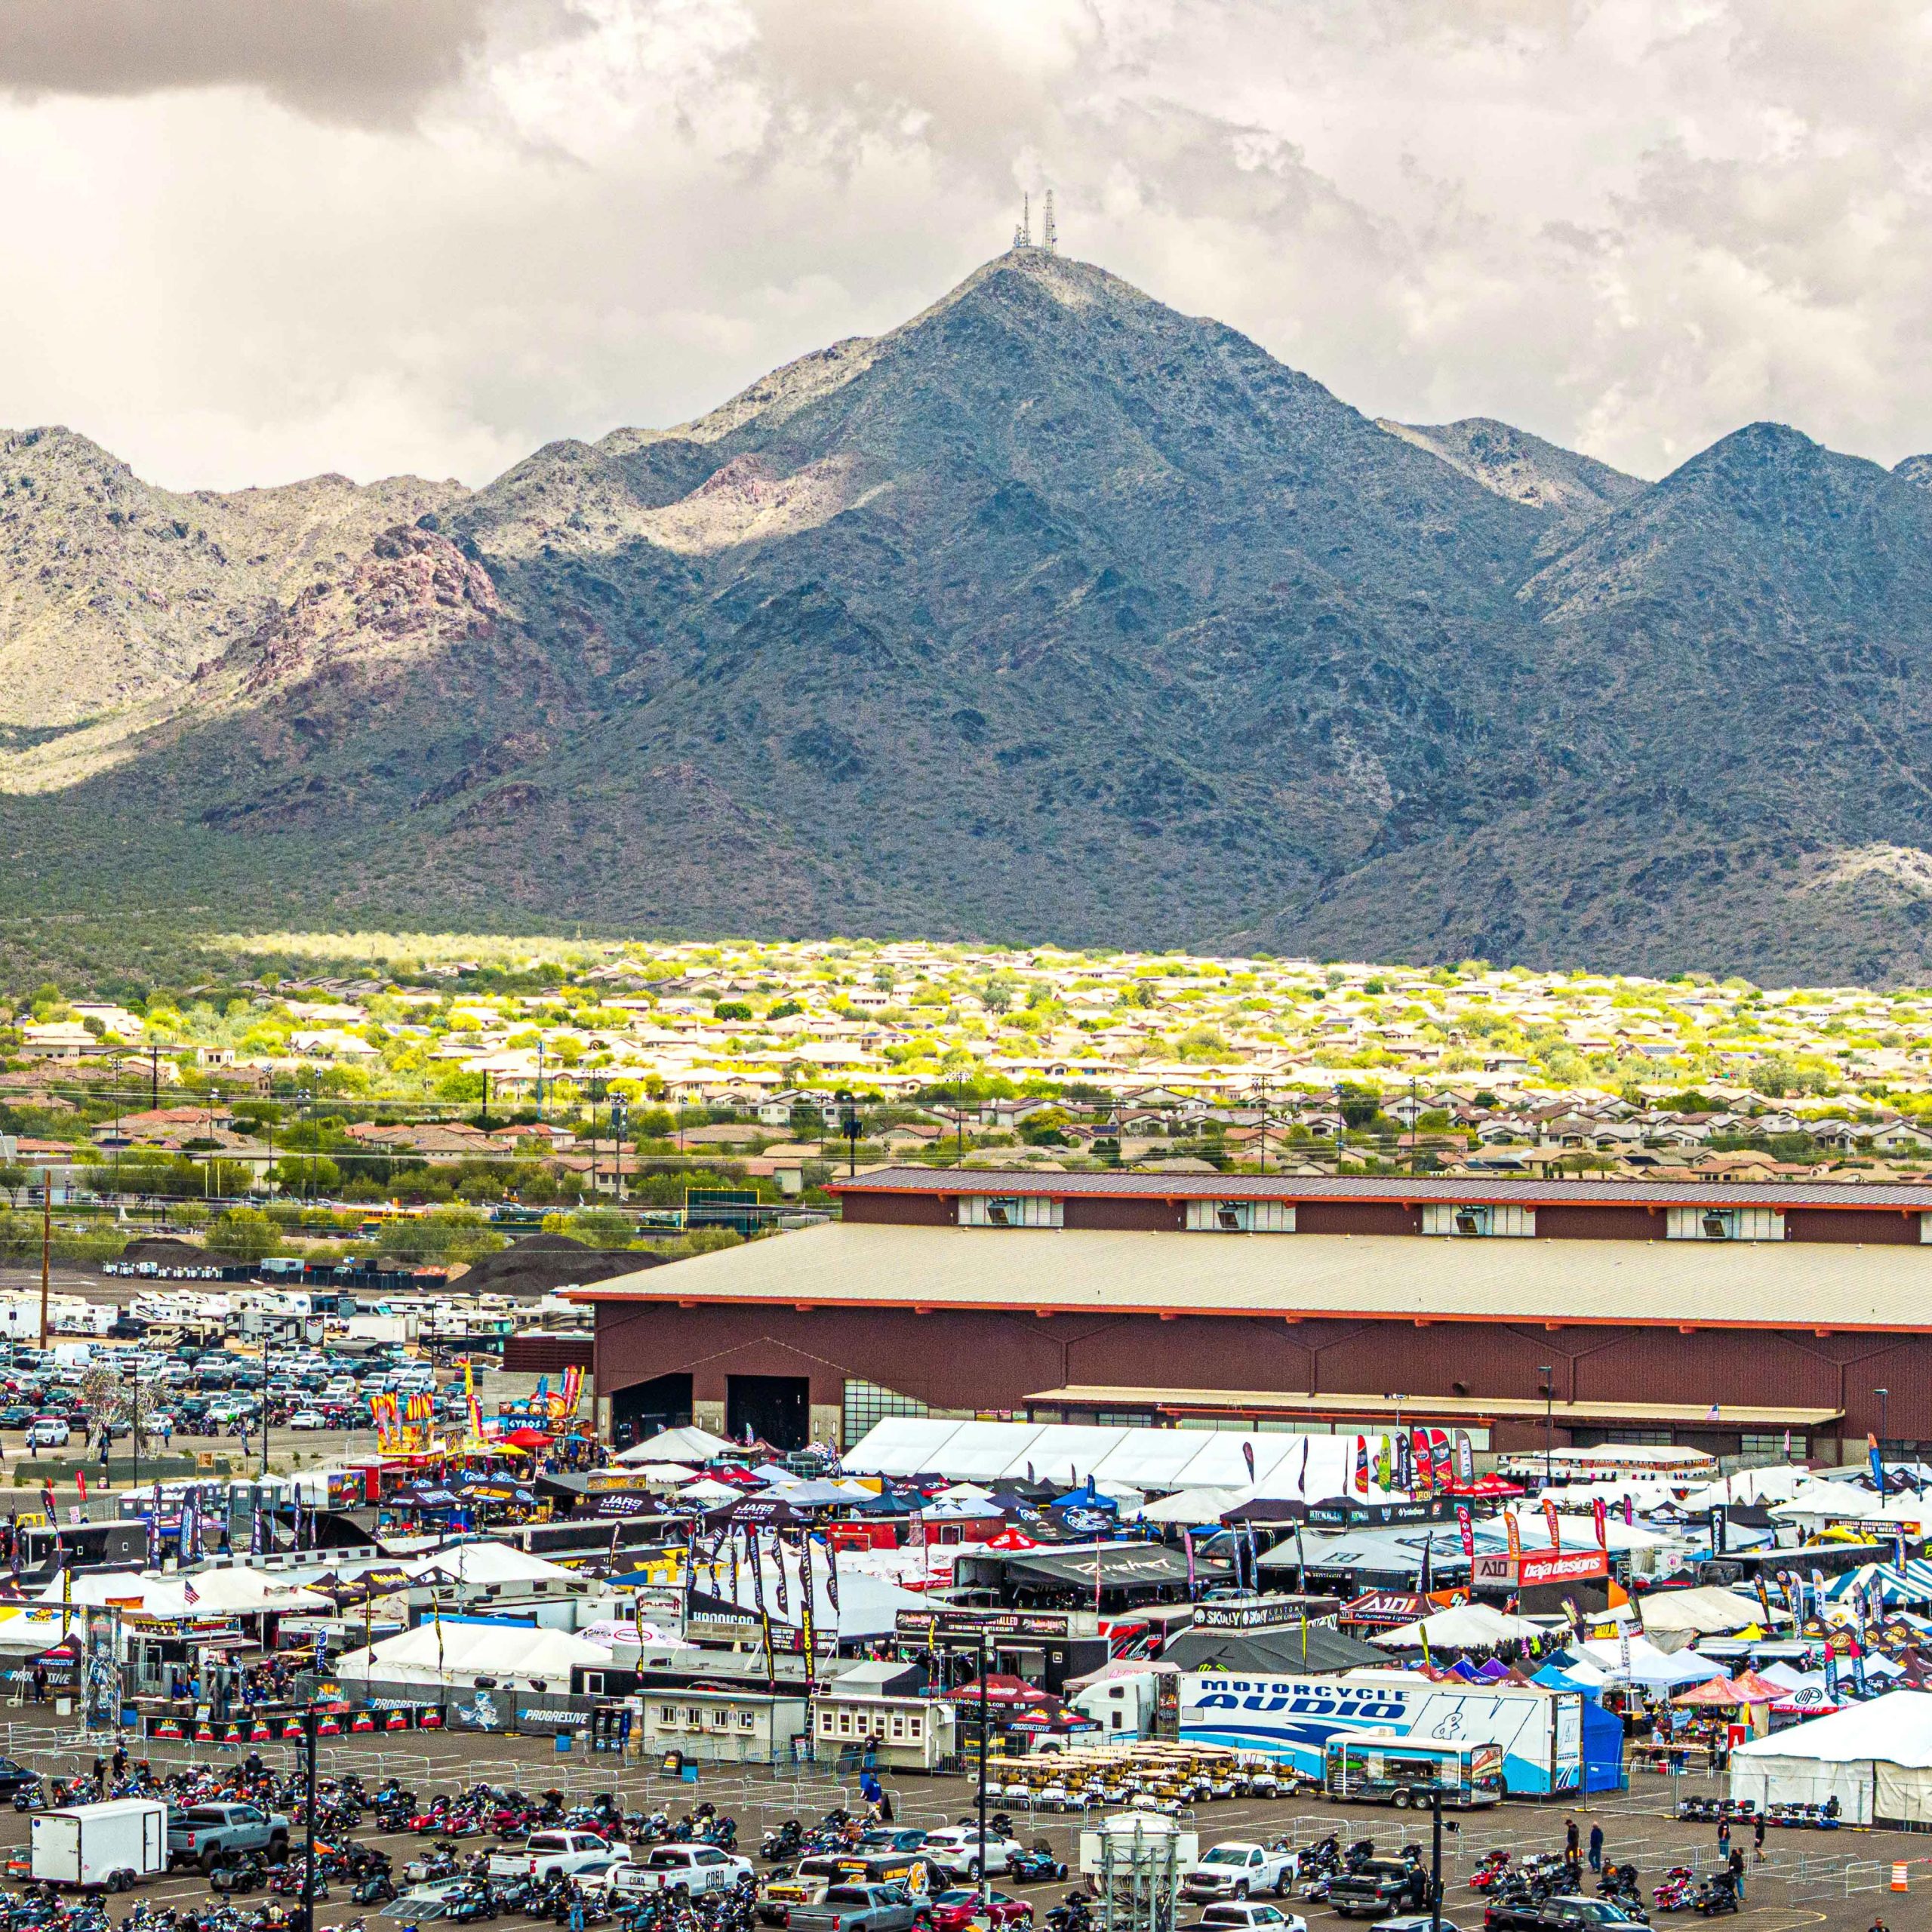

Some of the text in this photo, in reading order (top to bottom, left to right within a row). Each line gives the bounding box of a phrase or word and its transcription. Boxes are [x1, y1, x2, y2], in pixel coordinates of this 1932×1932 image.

[509, 1420, 541, 1429] GYROS
[603, 1495, 643, 1507] JARS
[737, 1503, 777, 1512] JARS
[1547, 1504, 1558, 1543] LIGHTING
[1509, 1516, 1519, 1558] LIGHTING
[1480, 1561, 1508, 1577] A10
[1524, 1556, 1601, 1580] baja designs
[636, 1595, 681, 1611] CHALLENGER
[1269, 1605, 1304, 1615] CUSTOMS
[1362, 1595, 1408, 1613] A10
[801, 1610, 813, 1651] OFFICE
[10, 1670, 72, 1684] PROSSIVE
[1201, 1679, 1411, 1703] MOTORCYCLE
[372, 1697, 436, 1709] PROGRESSIVE
[1194, 1694, 1406, 1719] AUDIO
[525, 1709, 590, 1724] PROGRESSIVE
[1010, 1723, 1052, 1732] PROGRESSIVE
